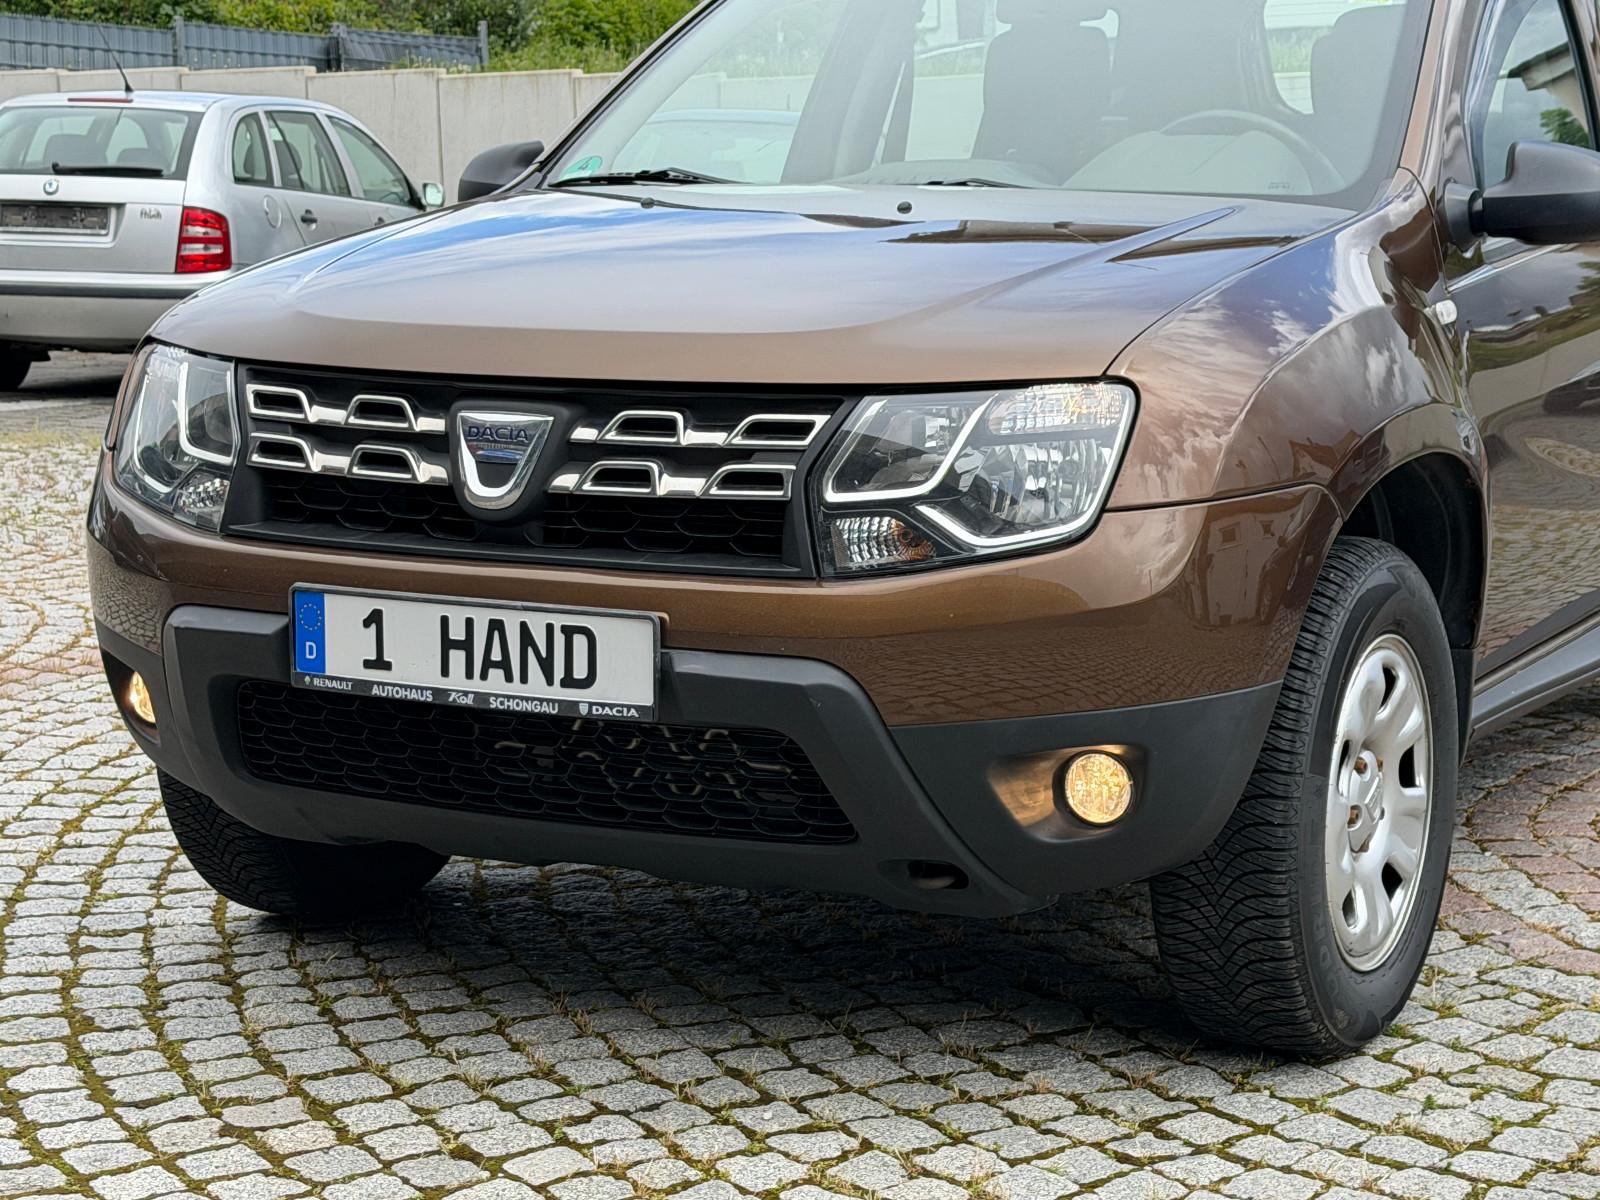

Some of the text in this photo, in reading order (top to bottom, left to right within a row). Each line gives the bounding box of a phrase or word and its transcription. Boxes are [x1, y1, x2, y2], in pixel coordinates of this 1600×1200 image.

[467, 426, 529, 442] DACIA
[305, 641, 317, 660] D
[362, 608, 598, 690] 1 HAND
[313, 677, 353, 690] RENAULT
[371, 684, 433, 701] AUTOHAUS
[489, 696, 559, 714] SCHONGAU
[592, 705, 640, 718] DACIA
